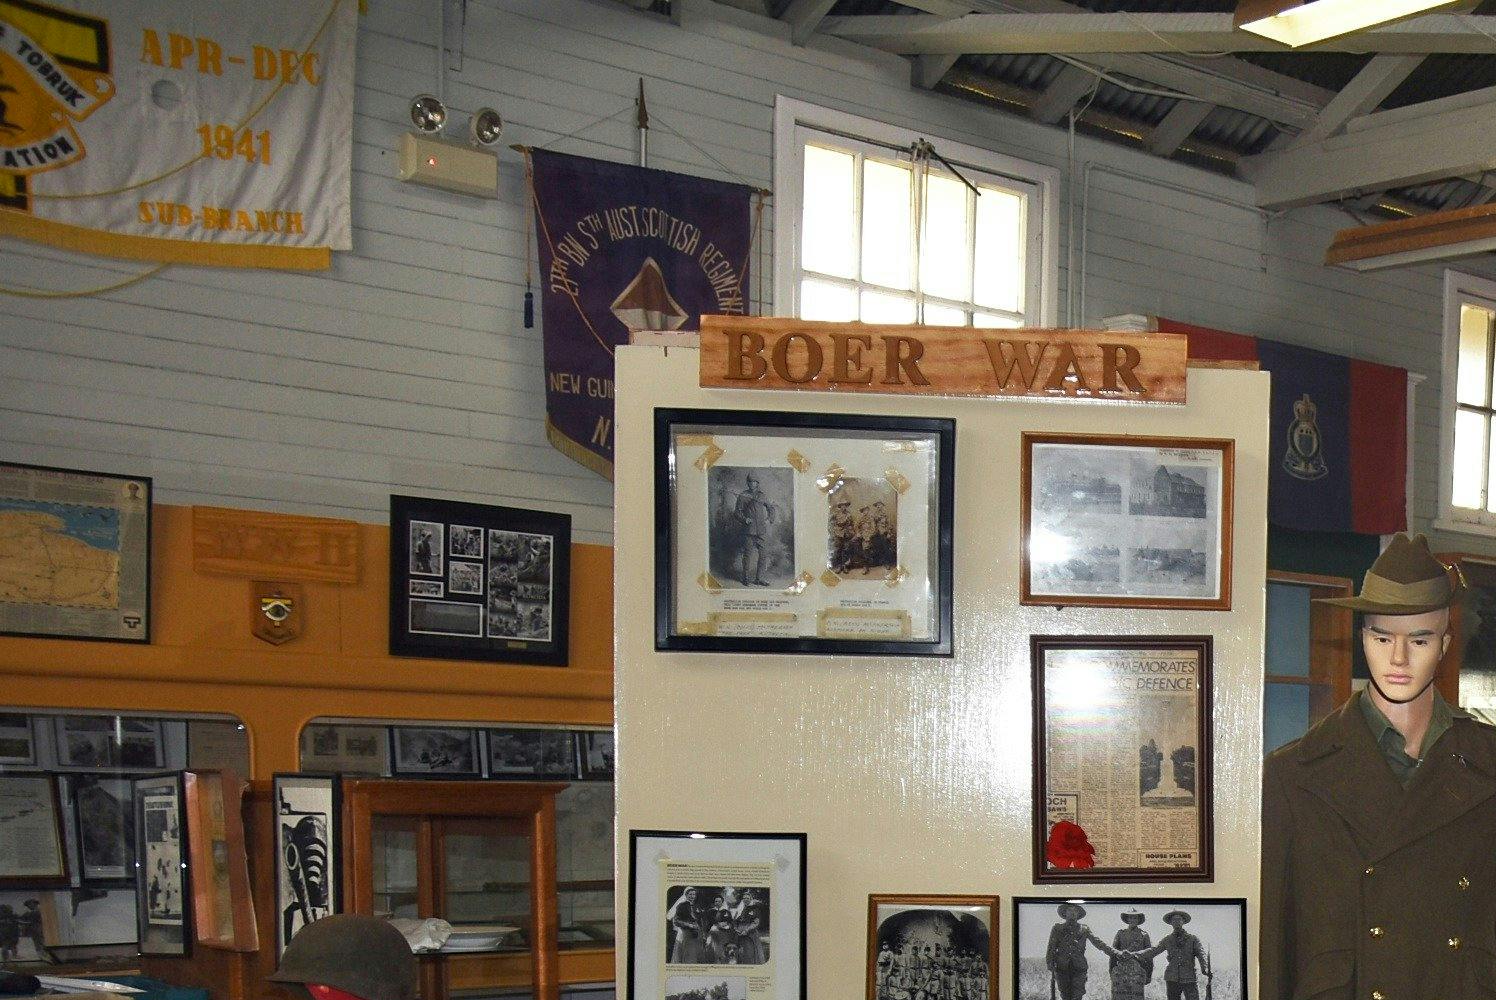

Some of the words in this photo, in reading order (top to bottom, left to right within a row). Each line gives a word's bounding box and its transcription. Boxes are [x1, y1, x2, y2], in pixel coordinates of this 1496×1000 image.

[16, 40, 87, 108] TOBRUK
[196, 122, 273, 166] 1941
[138, 200, 306, 235] SUB-BRANCH
[641, 207, 701, 256] SCOTTISH
[722, 328, 931, 387] BOER
[981, 337, 1148, 394] WAR
[550, 373, 581, 394] NEW
[1136, 677, 1193, 691] DEFENCE
